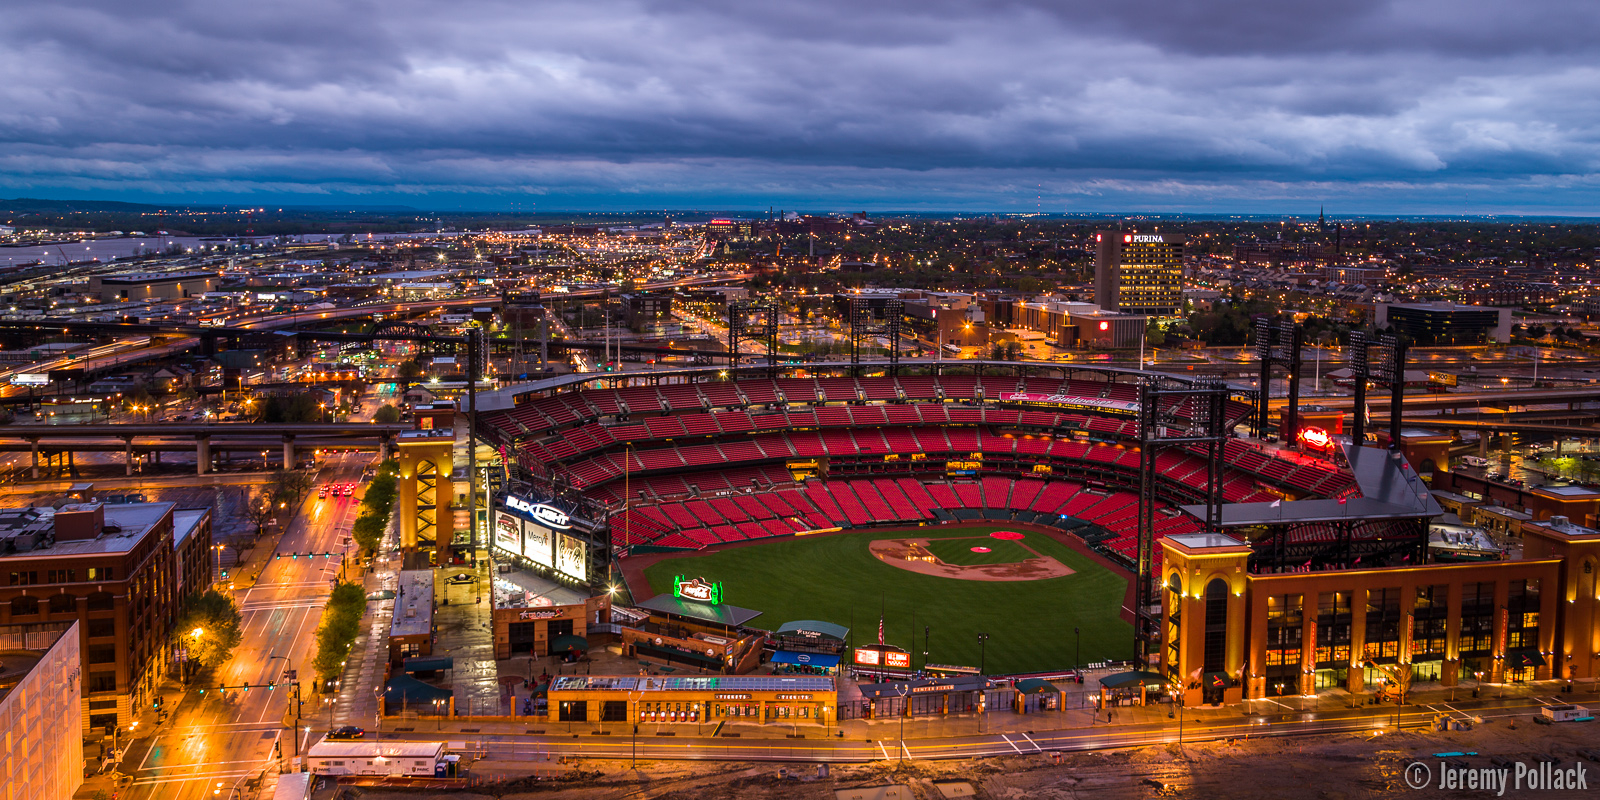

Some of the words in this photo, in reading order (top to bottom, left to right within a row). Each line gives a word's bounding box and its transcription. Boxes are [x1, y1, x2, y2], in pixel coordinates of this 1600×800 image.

[1133, 235, 1164, 243] PURINA
[1046, 394, 1114, 406] Budweiser
[506, 495, 530, 512] BUD
[534, 506, 570, 526] LIGHT
[528, 530, 546, 547] Mercy
